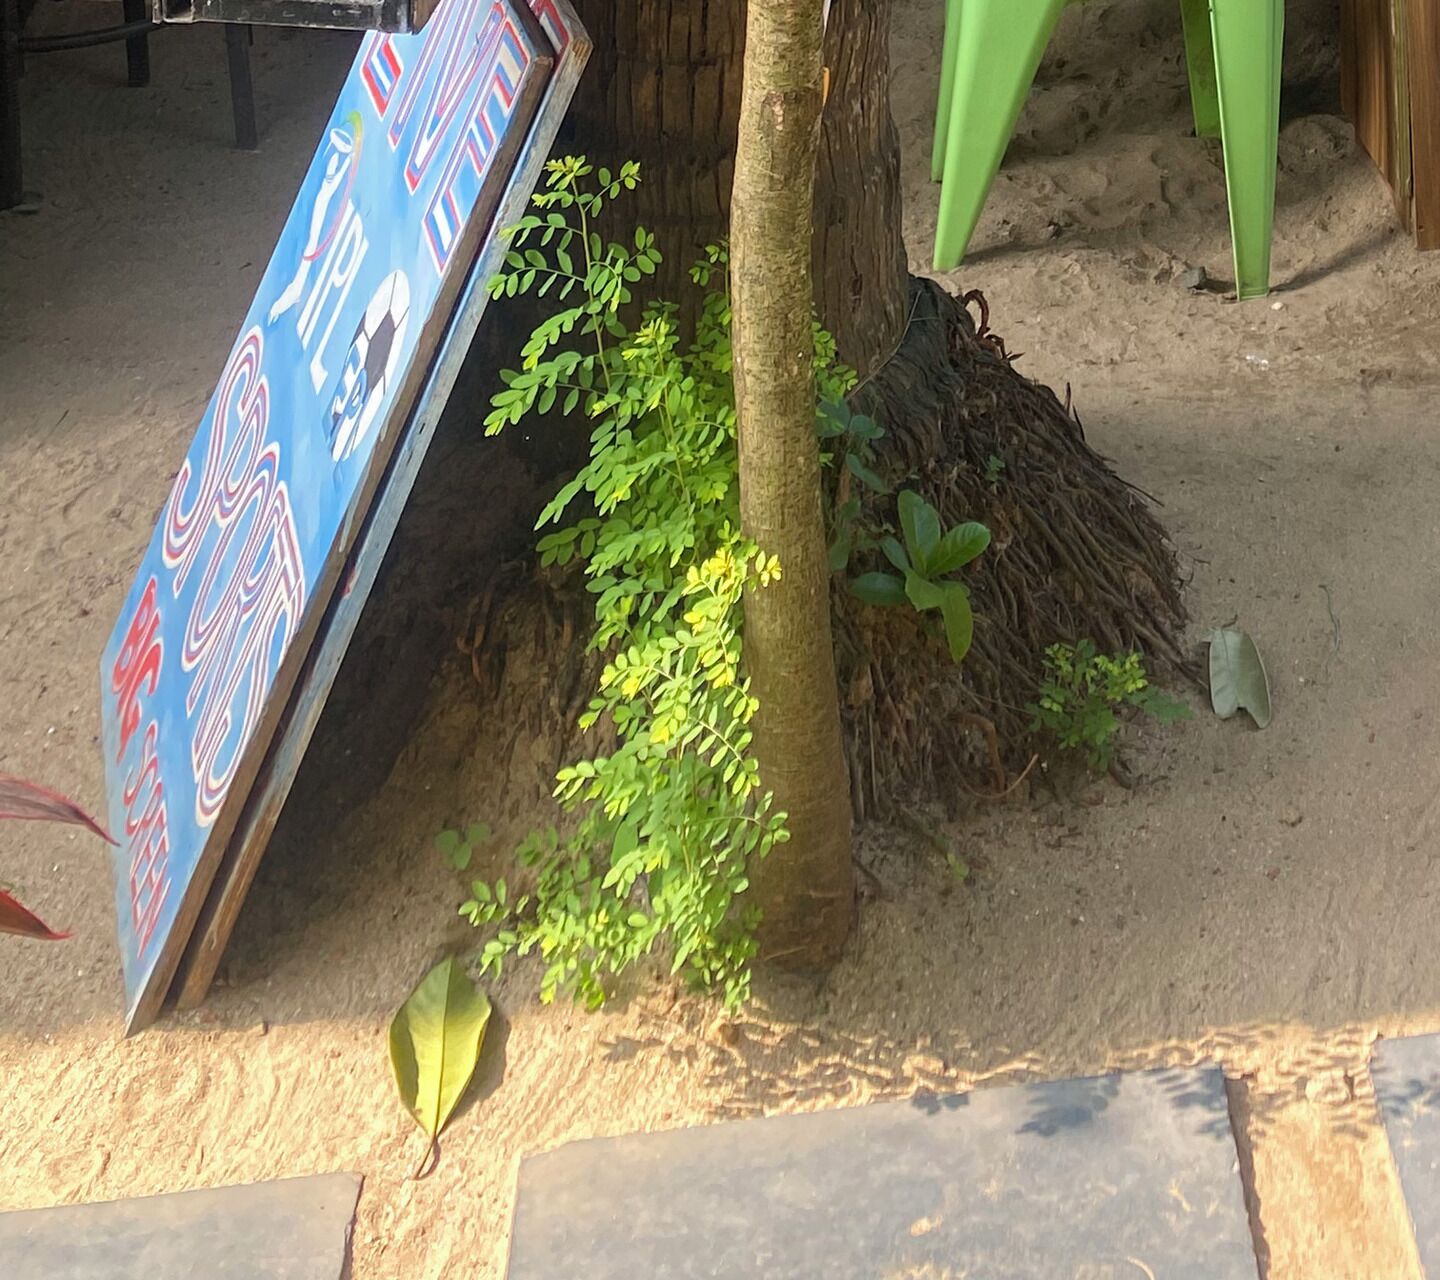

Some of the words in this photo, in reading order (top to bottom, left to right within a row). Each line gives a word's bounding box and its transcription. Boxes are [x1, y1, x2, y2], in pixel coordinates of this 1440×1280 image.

[297, 198, 369, 396] IPL
[112, 574, 164, 766] BIG
[162, 324, 305, 828] SPORTS
[123, 720, 171, 960] SCREEN
